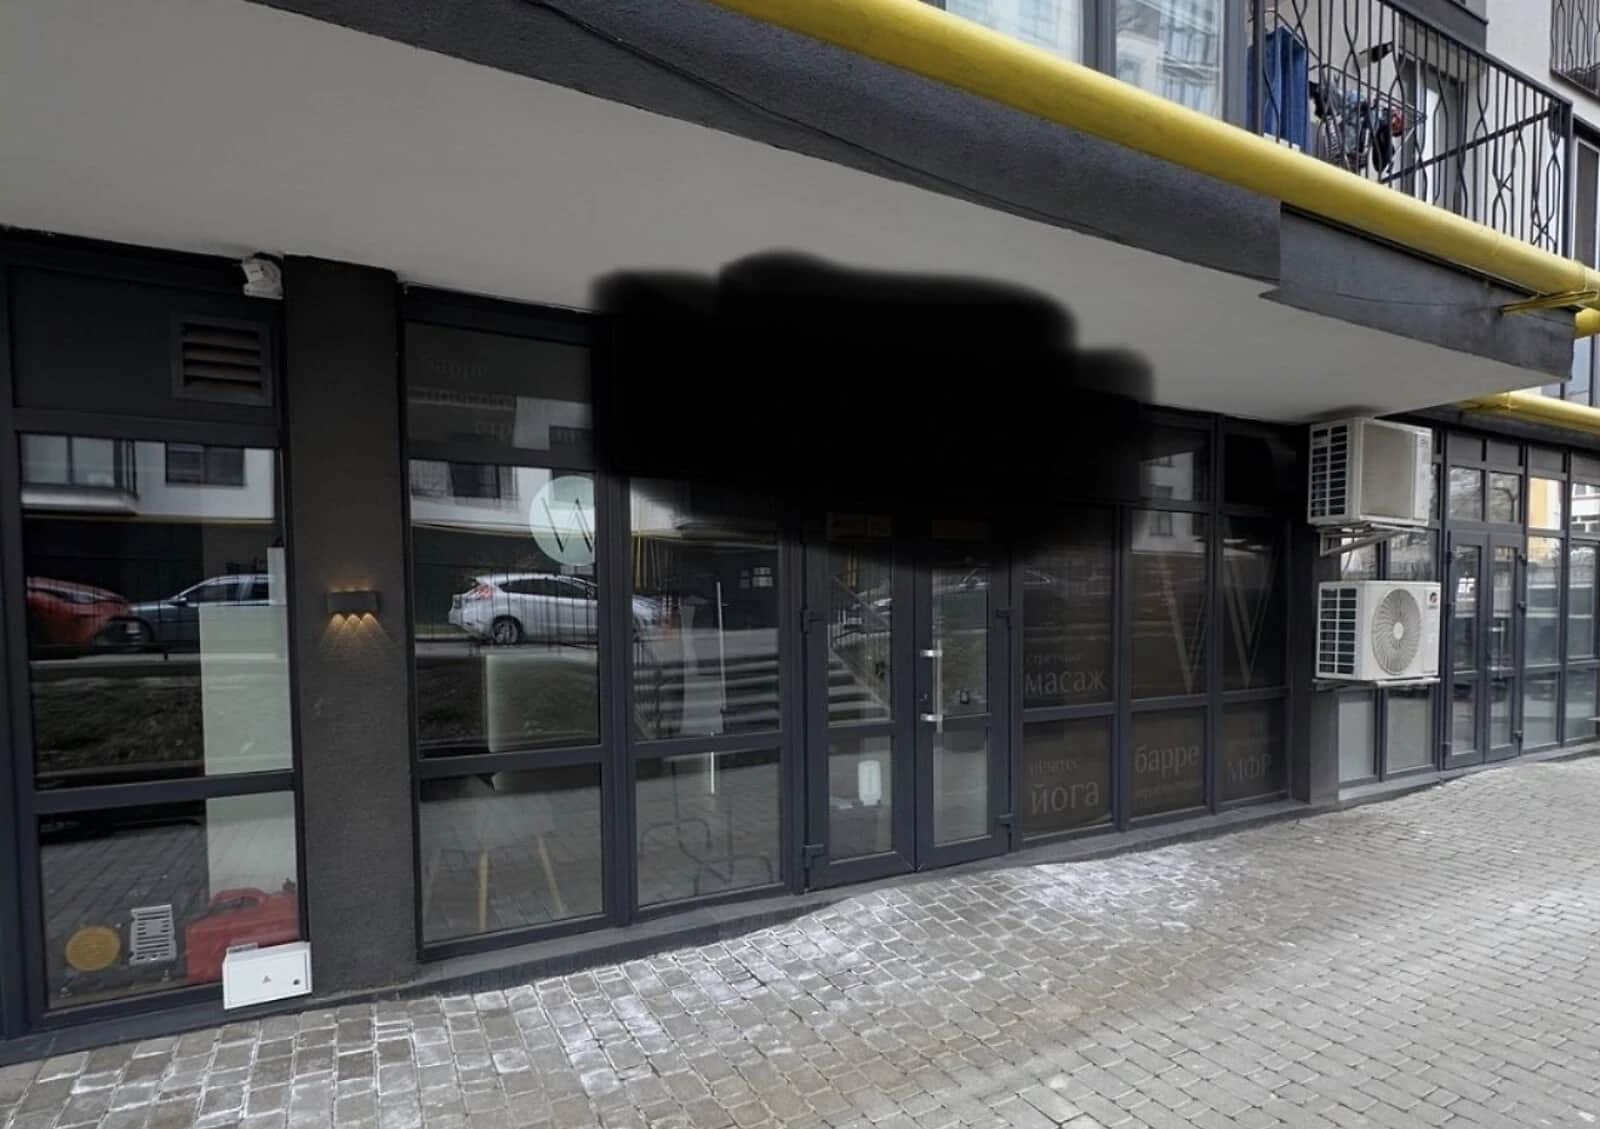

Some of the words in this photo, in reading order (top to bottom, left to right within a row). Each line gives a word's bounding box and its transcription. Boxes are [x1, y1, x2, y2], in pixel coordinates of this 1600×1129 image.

[1025, 670, 1105, 697] масаж
[1135, 744, 1200, 780] барре
[1031, 782, 1099, 816] йога
